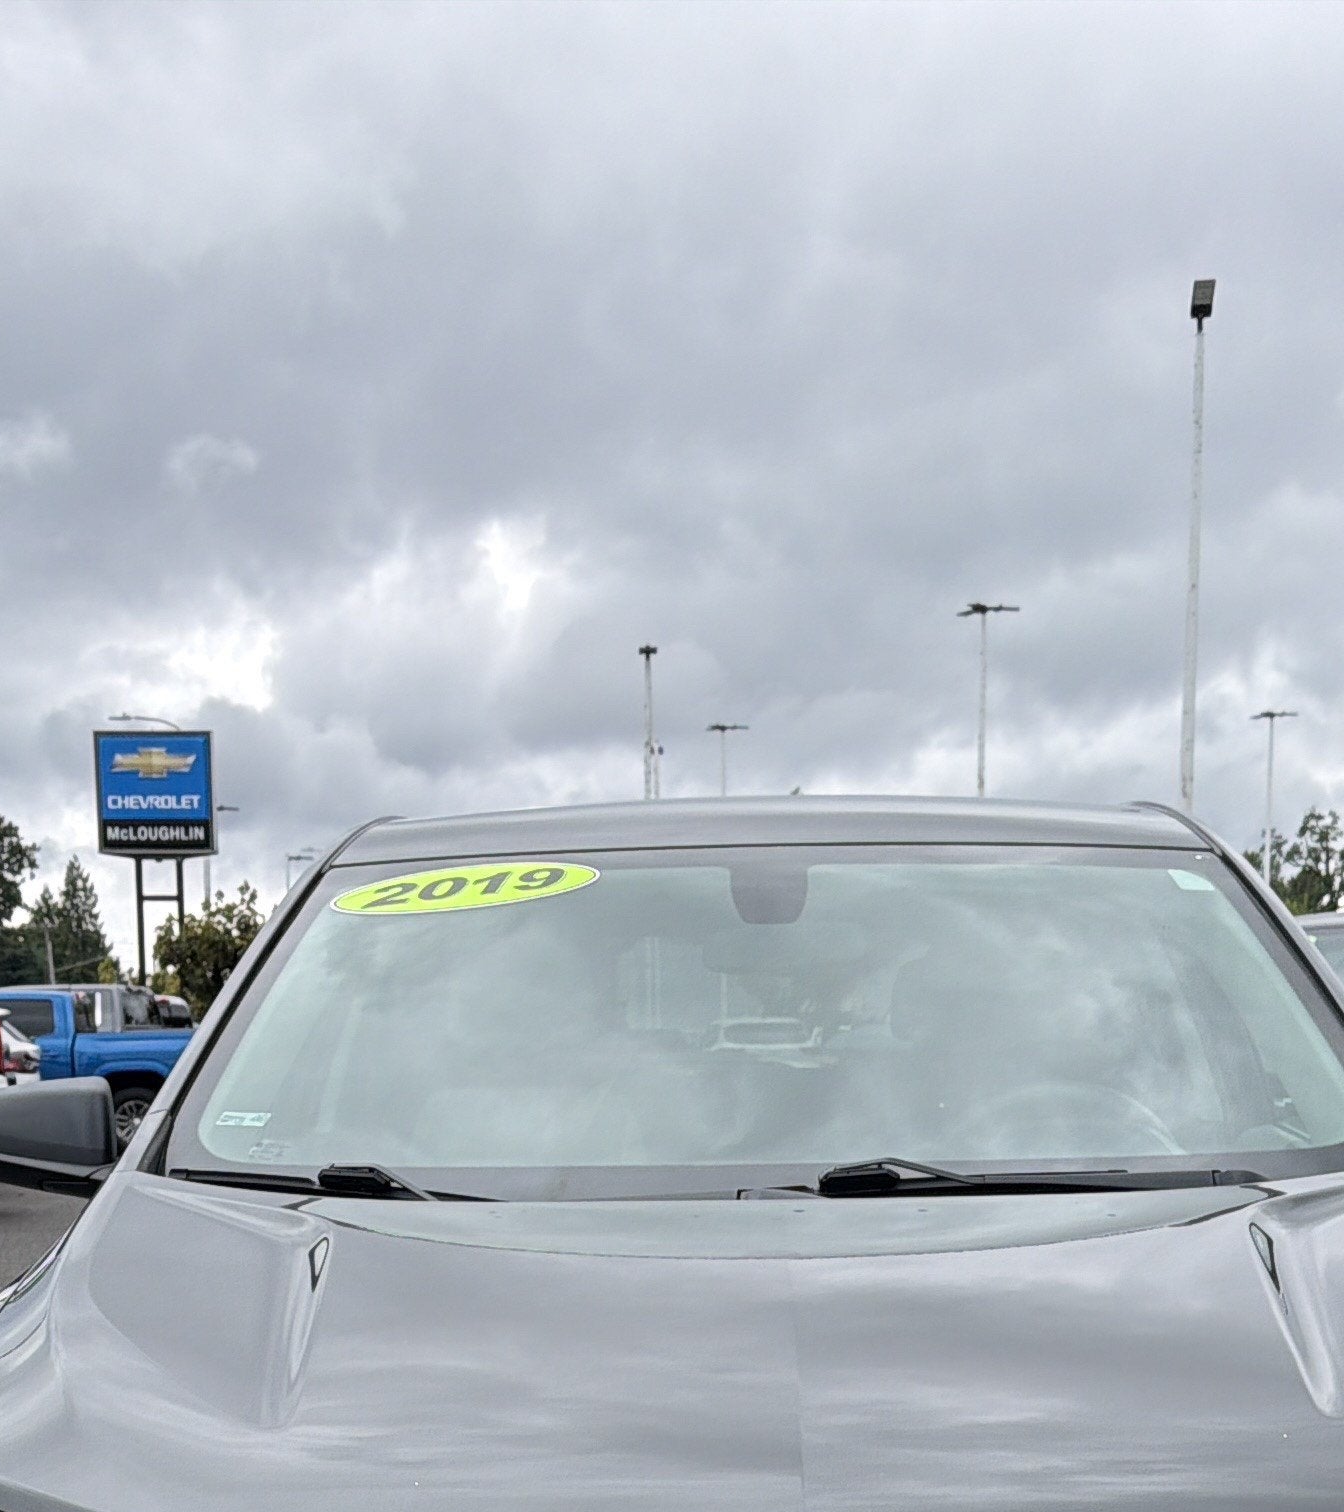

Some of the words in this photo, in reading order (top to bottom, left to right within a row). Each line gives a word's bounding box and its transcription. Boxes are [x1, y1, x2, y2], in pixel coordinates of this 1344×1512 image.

[107, 794, 201, 810] CHEVROLET
[106, 825, 205, 841] McLOUGHLIN
[360, 867, 566, 910] 2019
